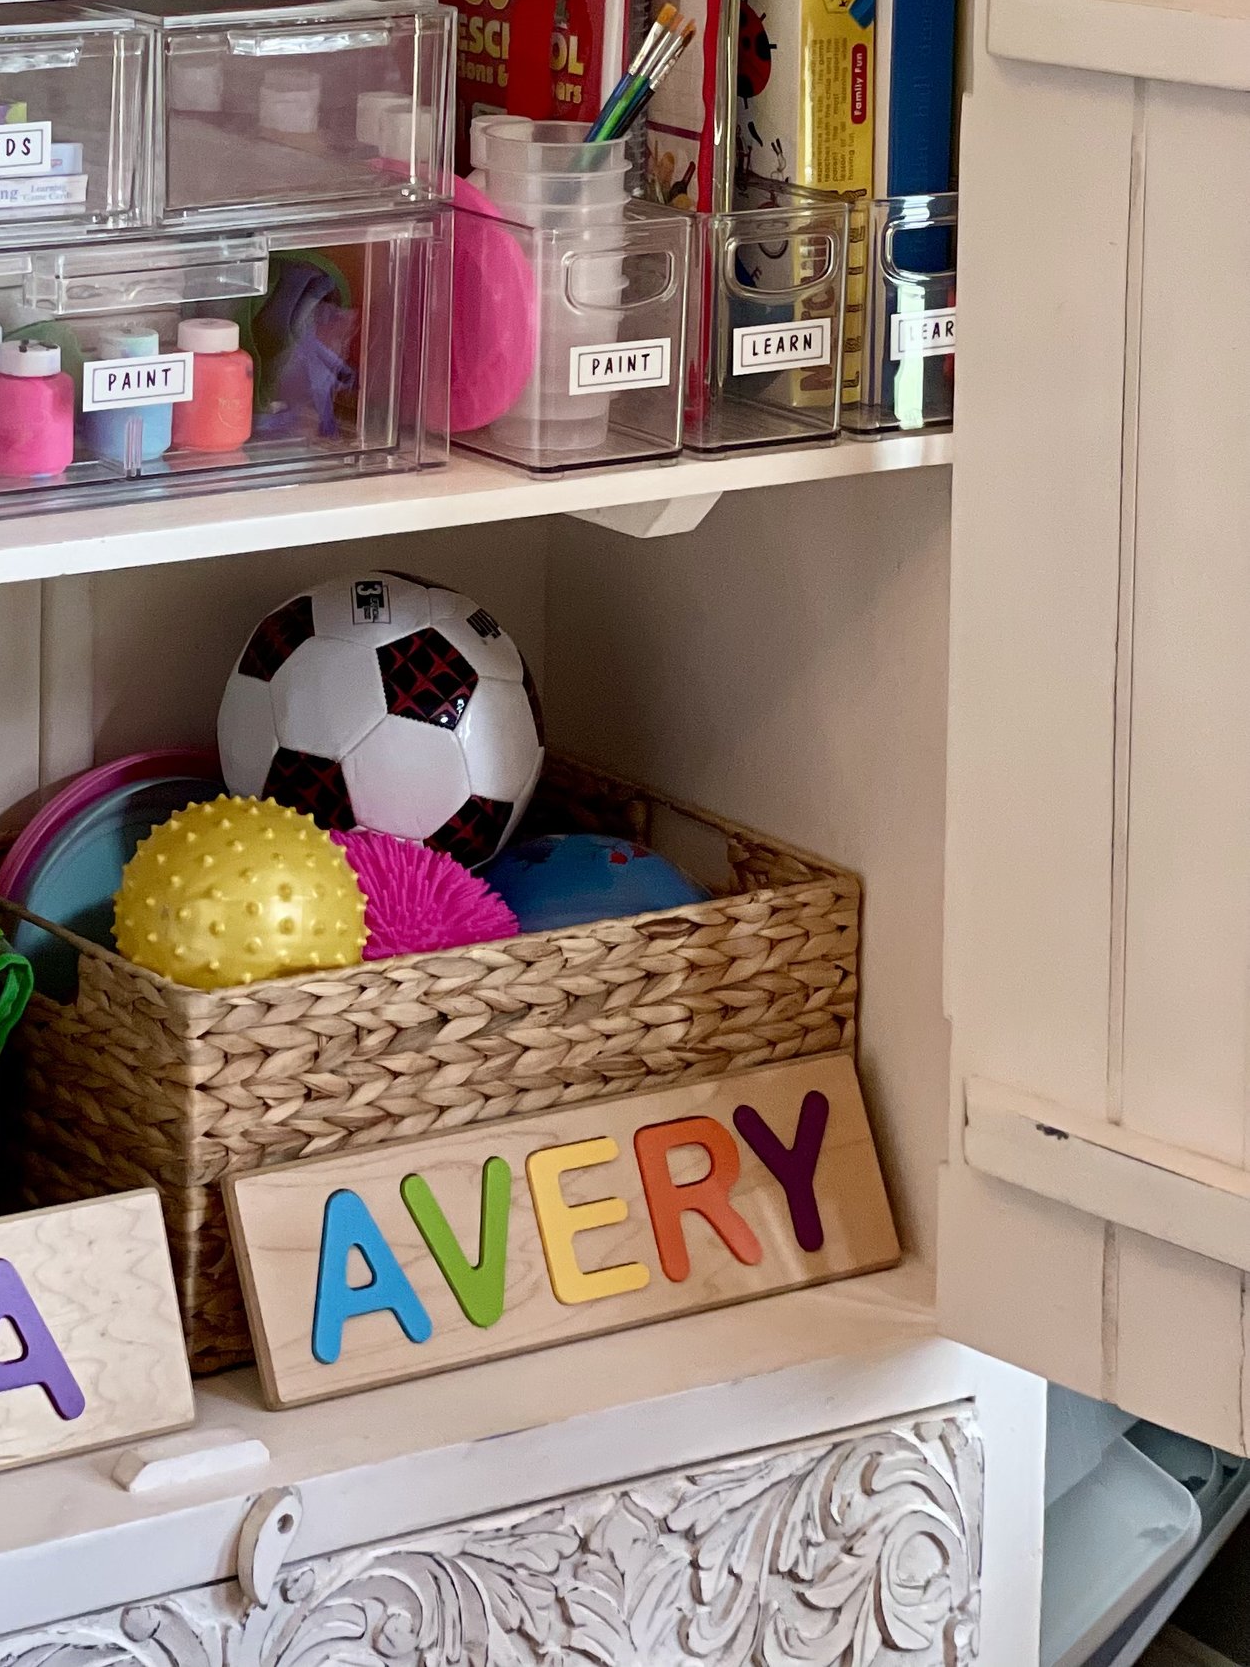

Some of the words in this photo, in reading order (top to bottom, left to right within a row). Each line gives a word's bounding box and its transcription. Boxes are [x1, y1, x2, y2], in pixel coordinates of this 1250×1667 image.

[854, 78, 863, 115] Family
[908, 319, 955, 341] LEAR
[752, 332, 813, 357] LEARN
[592, 353, 650, 376] PAINT
[108, 367, 172, 392] PAINT
[312, 1090, 829, 1365] AVERY
